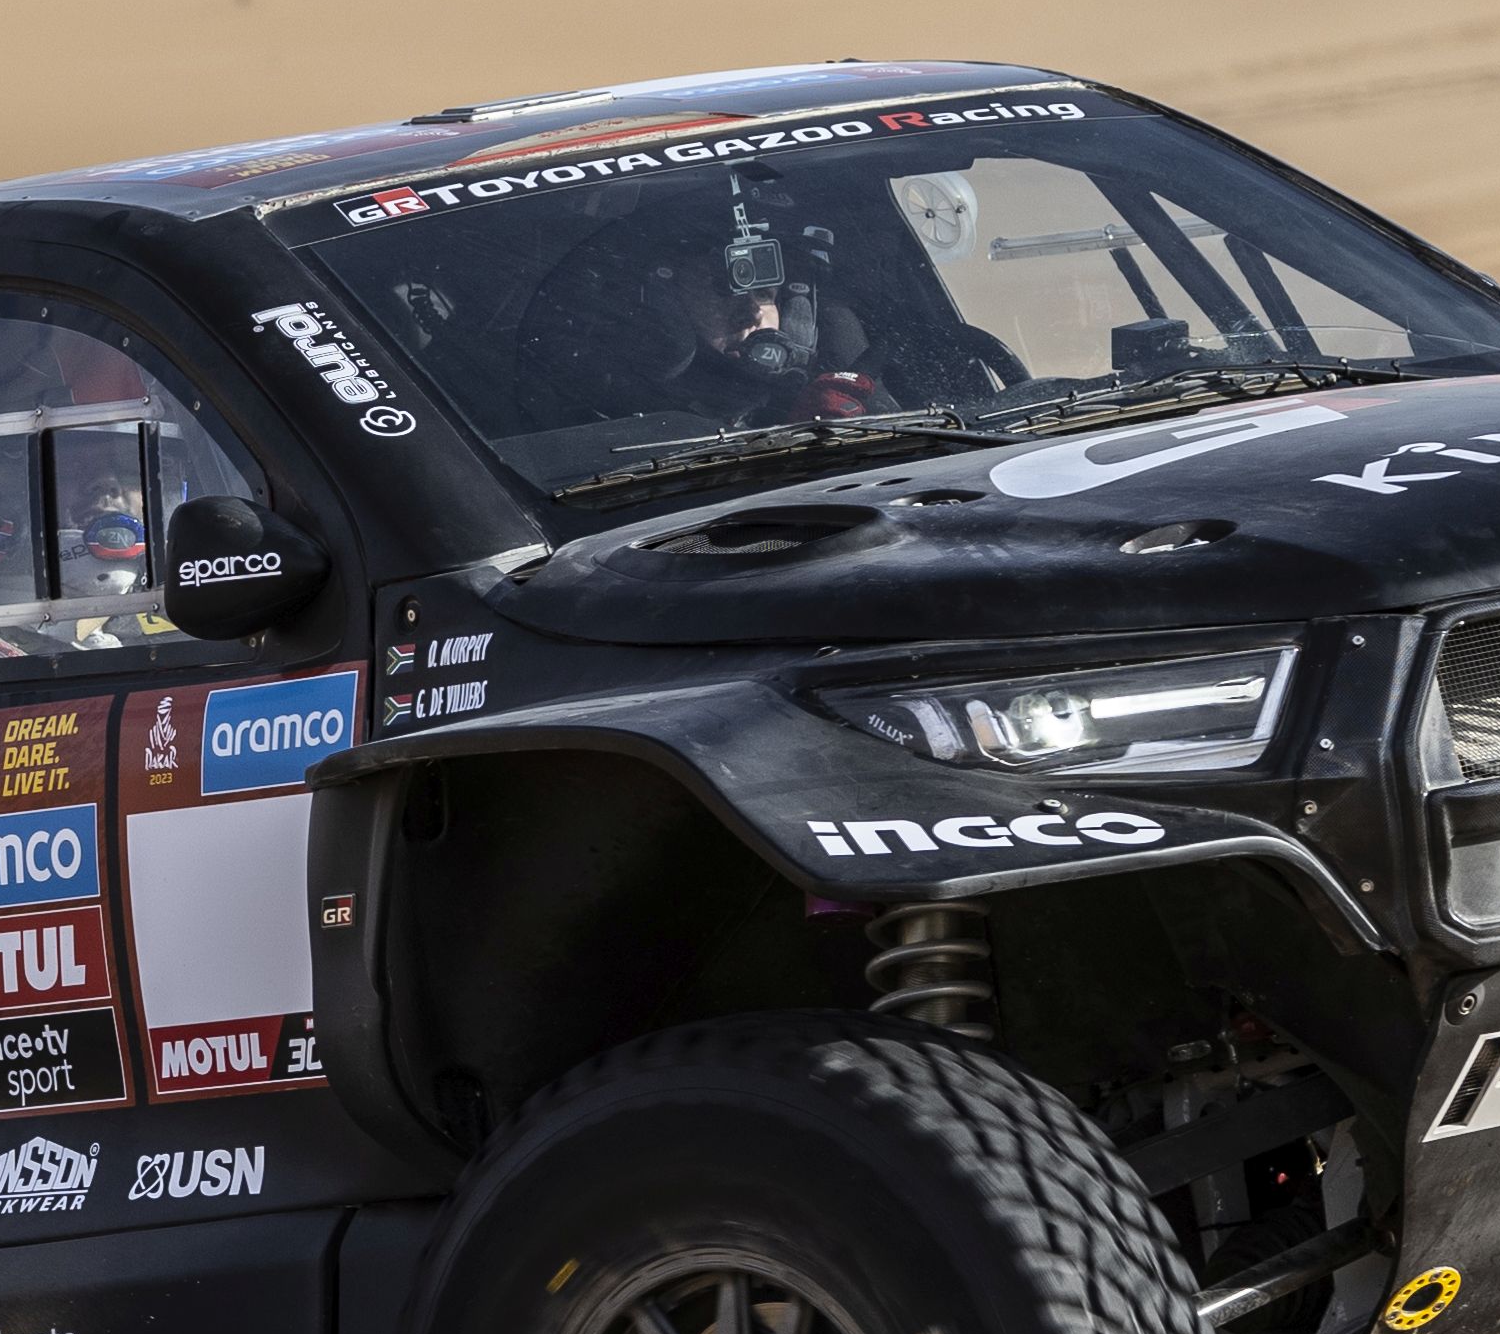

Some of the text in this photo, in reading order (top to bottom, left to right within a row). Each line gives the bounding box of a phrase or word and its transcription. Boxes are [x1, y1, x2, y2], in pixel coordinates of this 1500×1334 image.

[348, 196, 425, 224] GR
[418, 151, 661, 205] TOYOTA
[663, 121, 872, 162] GAZOO
[878, 102, 1086, 131] Racing
[306, 301, 397, 399] LUBRICANTS
[179, 552, 281, 587] sparco
[440, 633, 493, 666] MURPHY
[416, 680, 488, 718] G. DE VILLIERS
[4, 713, 79, 742] DREAM.
[211, 709, 344, 757] aramco
[3, 742, 59, 770] DARE.
[2, 767, 70, 797] LIVE IT.
[150, 772, 172, 785] 2023
[323, 907, 350, 924] GR
[161, 1033, 267, 1079] MOTUL
[8, 1059, 75, 1107] sport
[168, 1146, 265, 1198] USN
